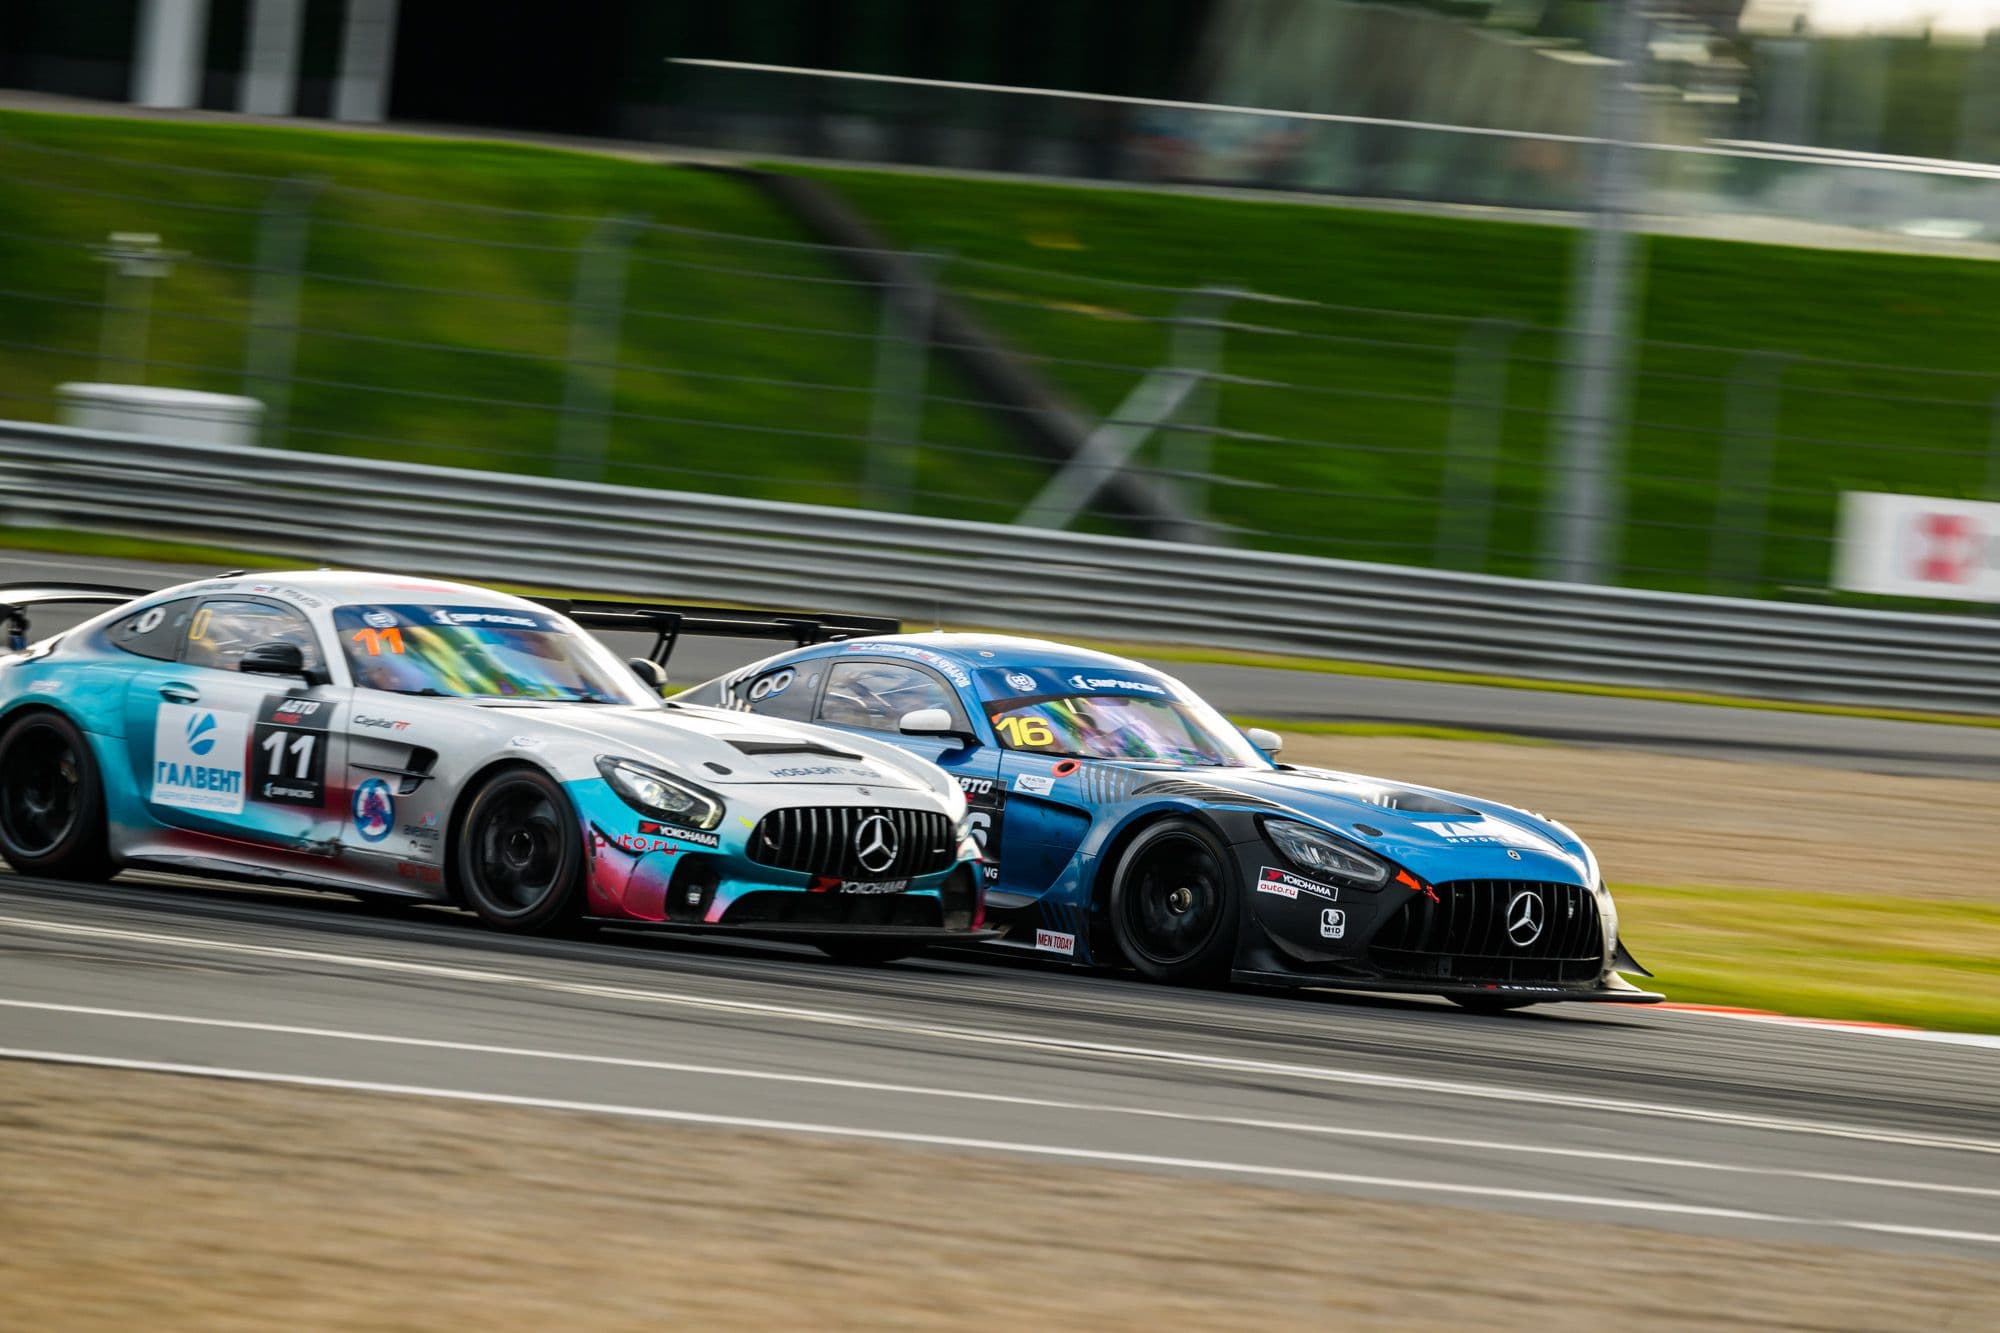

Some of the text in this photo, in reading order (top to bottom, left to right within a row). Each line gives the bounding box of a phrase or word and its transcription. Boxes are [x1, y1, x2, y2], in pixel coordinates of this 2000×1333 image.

[352, 627, 405, 656] 11
[996, 717, 1053, 746] 16
[262, 731, 316, 779] 11
[157, 761, 241, 793] ГАЛВЕНТ
[956, 777, 993, 794] ВТО
[660, 825, 718, 847] YOKOHAMA
[840, 880, 907, 895] YOKOHAMA
[1260, 883, 1296, 897] auto.ru
[1282, 873, 1331, 897] YOKOHAMA
[1038, 933, 1073, 950] MEN TODAY
